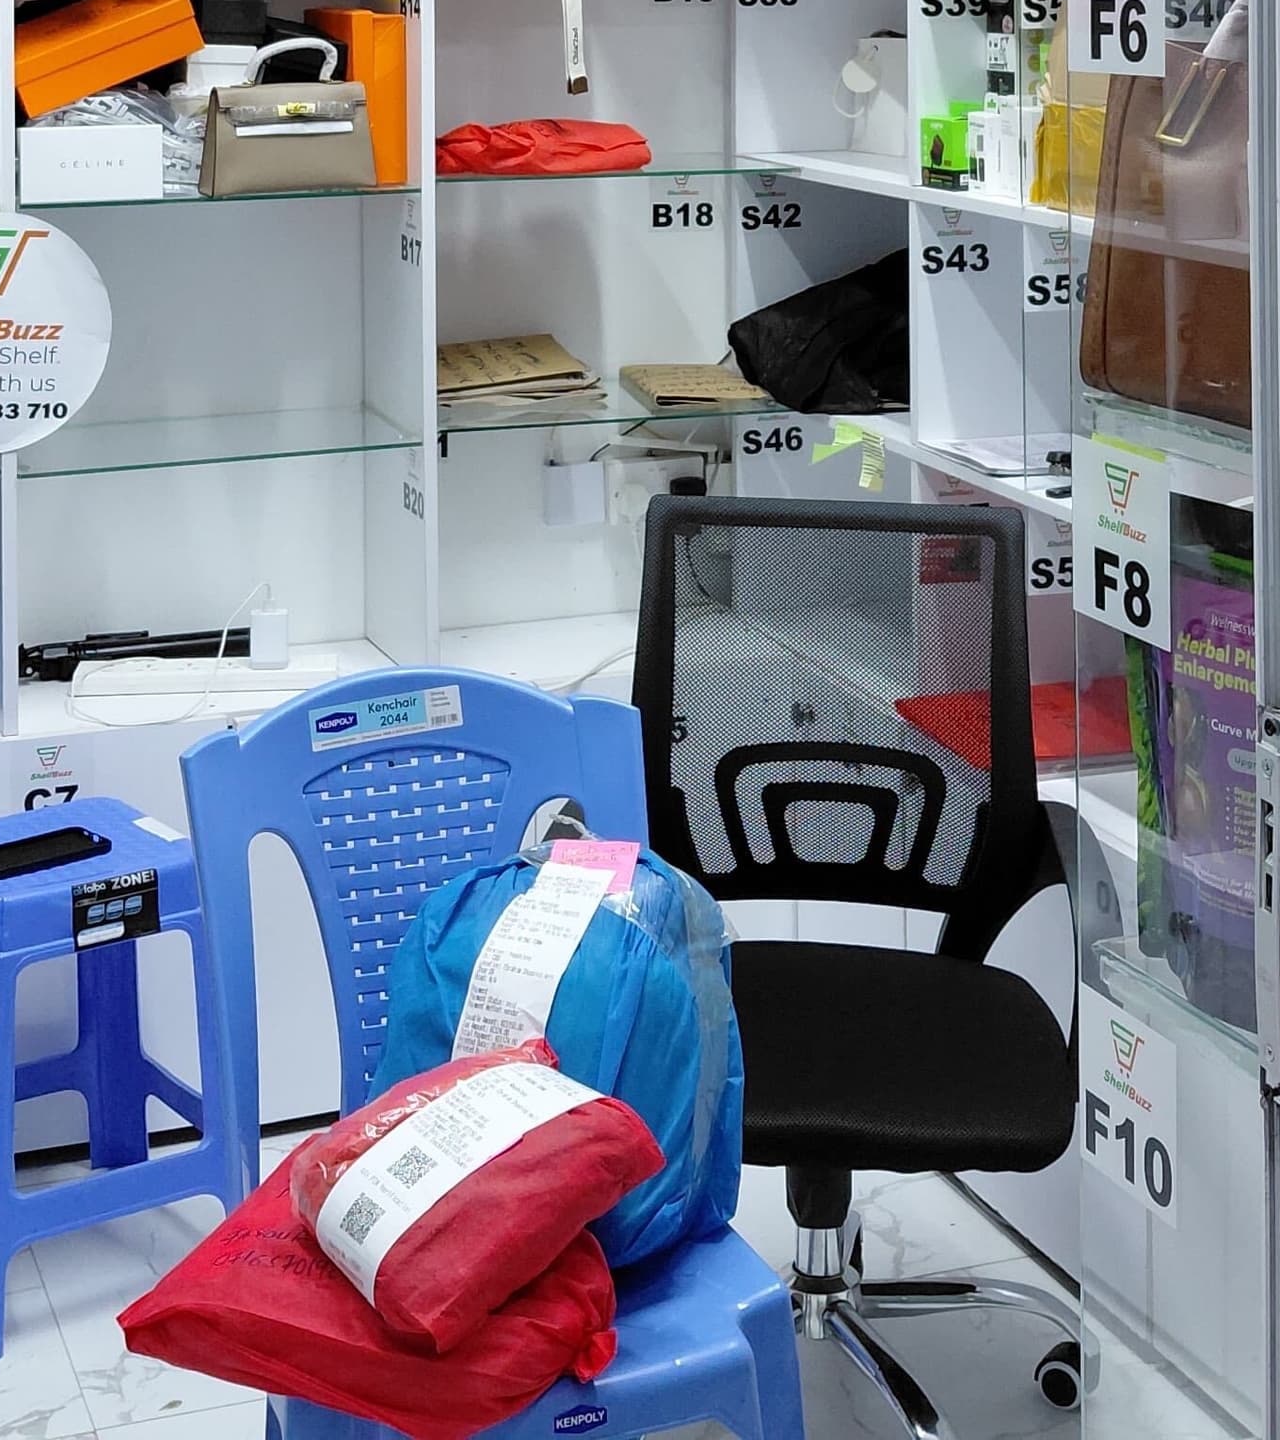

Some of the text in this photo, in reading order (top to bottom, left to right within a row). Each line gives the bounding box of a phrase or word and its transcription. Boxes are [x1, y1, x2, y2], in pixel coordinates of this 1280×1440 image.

[652, 203, 714, 229] B18
[741, 204, 802, 231] S42
[401, 235, 422, 267] B17
[921, 243, 989, 275] S43
[29, 378, 56, 393] us
[27, 402, 68, 420] 710
[742, 426, 803, 455] S46
[403, 482, 424, 520] B20
[1098, 513, 1147, 543] ShelfBuzz
[1094, 546, 1152, 628] F8
[1177, 633, 1230, 663] Herbal
[367, 696, 418, 715] Kenchair
[318, 715, 356, 730] KENPOLY
[380, 713, 409, 727] 2044
[1211, 719, 1242, 738] Curve
[110, 869, 155, 890] ZONE!
[1104, 1070, 1153, 1112] ShelfBuzz
[1085, 1089, 1173, 1208] F10
[556, 1409, 607, 1429] KENPOLY
